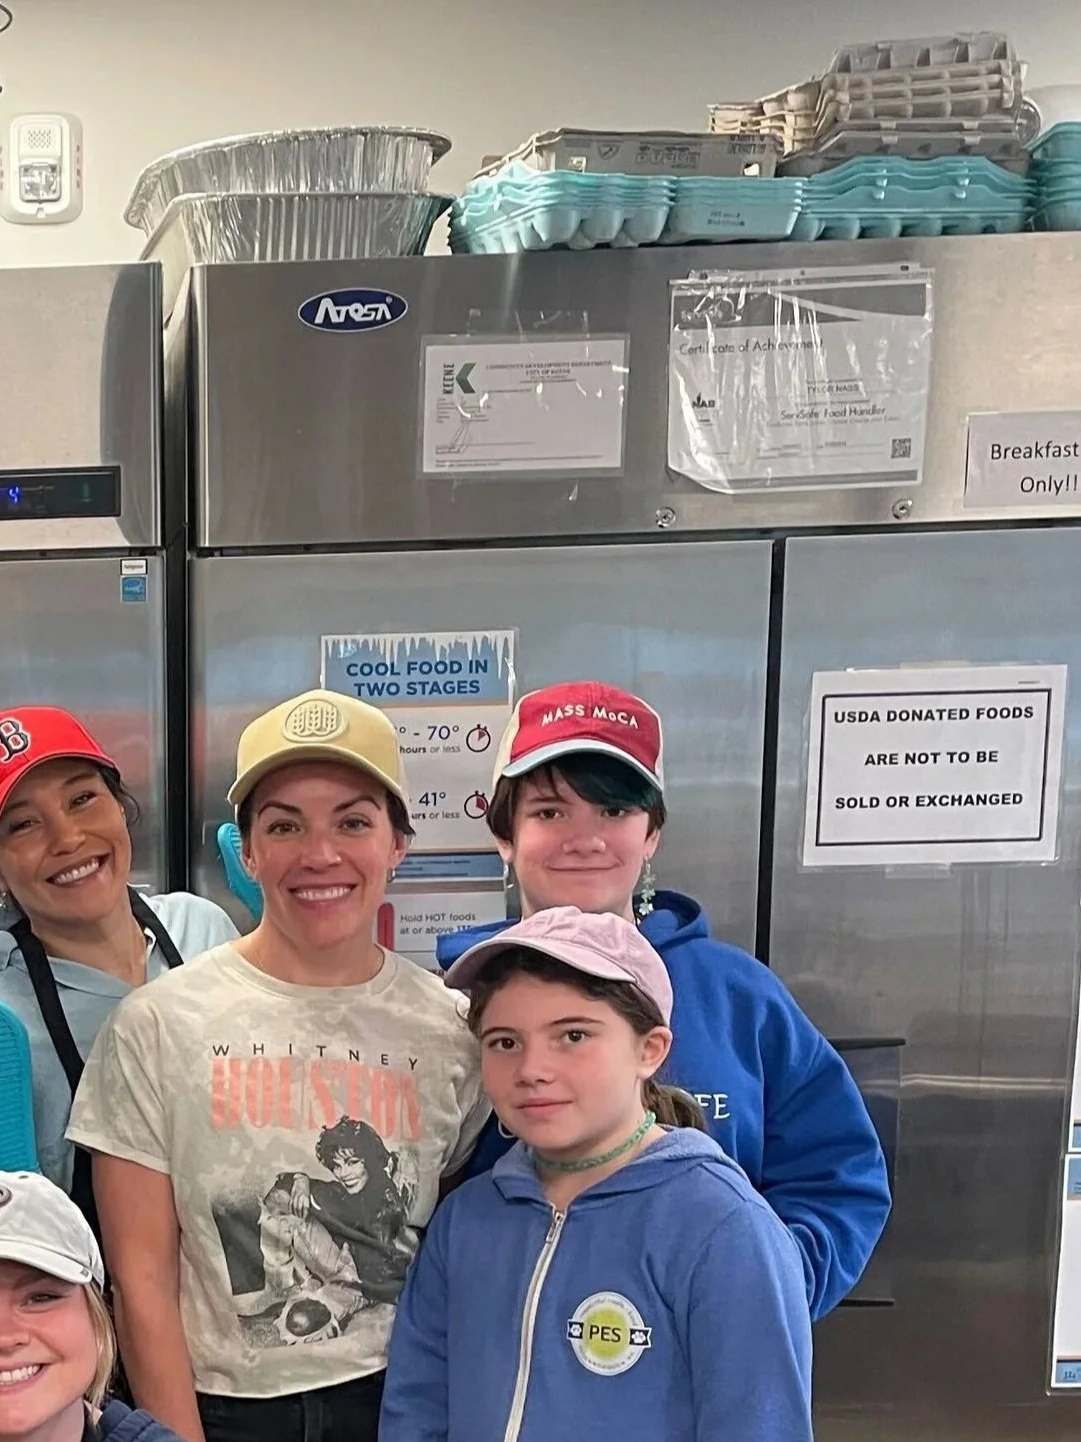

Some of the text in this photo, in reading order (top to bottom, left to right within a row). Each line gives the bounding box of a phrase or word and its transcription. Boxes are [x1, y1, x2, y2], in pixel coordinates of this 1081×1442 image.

[679, 341, 735, 355] Certifcate
[991, 440, 1079, 460] Breakfast
[1020, 473, 1078, 496] Only!!
[346, 659, 488, 677] COOL FOOD IN
[353, 679, 481, 697] TWO STAGES
[541, 704, 585, 728] MASS
[833, 706, 1034, 724] USDA DONATED FOODS
[427, 725, 460, 741] 70°
[399, 745, 427, 754] hours
[442, 745, 461, 753] less
[864, 750, 999, 766] ARE NOT TO BE
[418, 791, 446, 807] 41°
[835, 792, 1024, 810] SOLD OR EXCHANGED
[441, 811, 460, 819] less
[400, 912, 476, 922] Hold HOT foods
[399, 927, 409, 935] at
[212, 1043, 418, 1071] WHITNEY
[589, 1324, 622, 1343] PES
